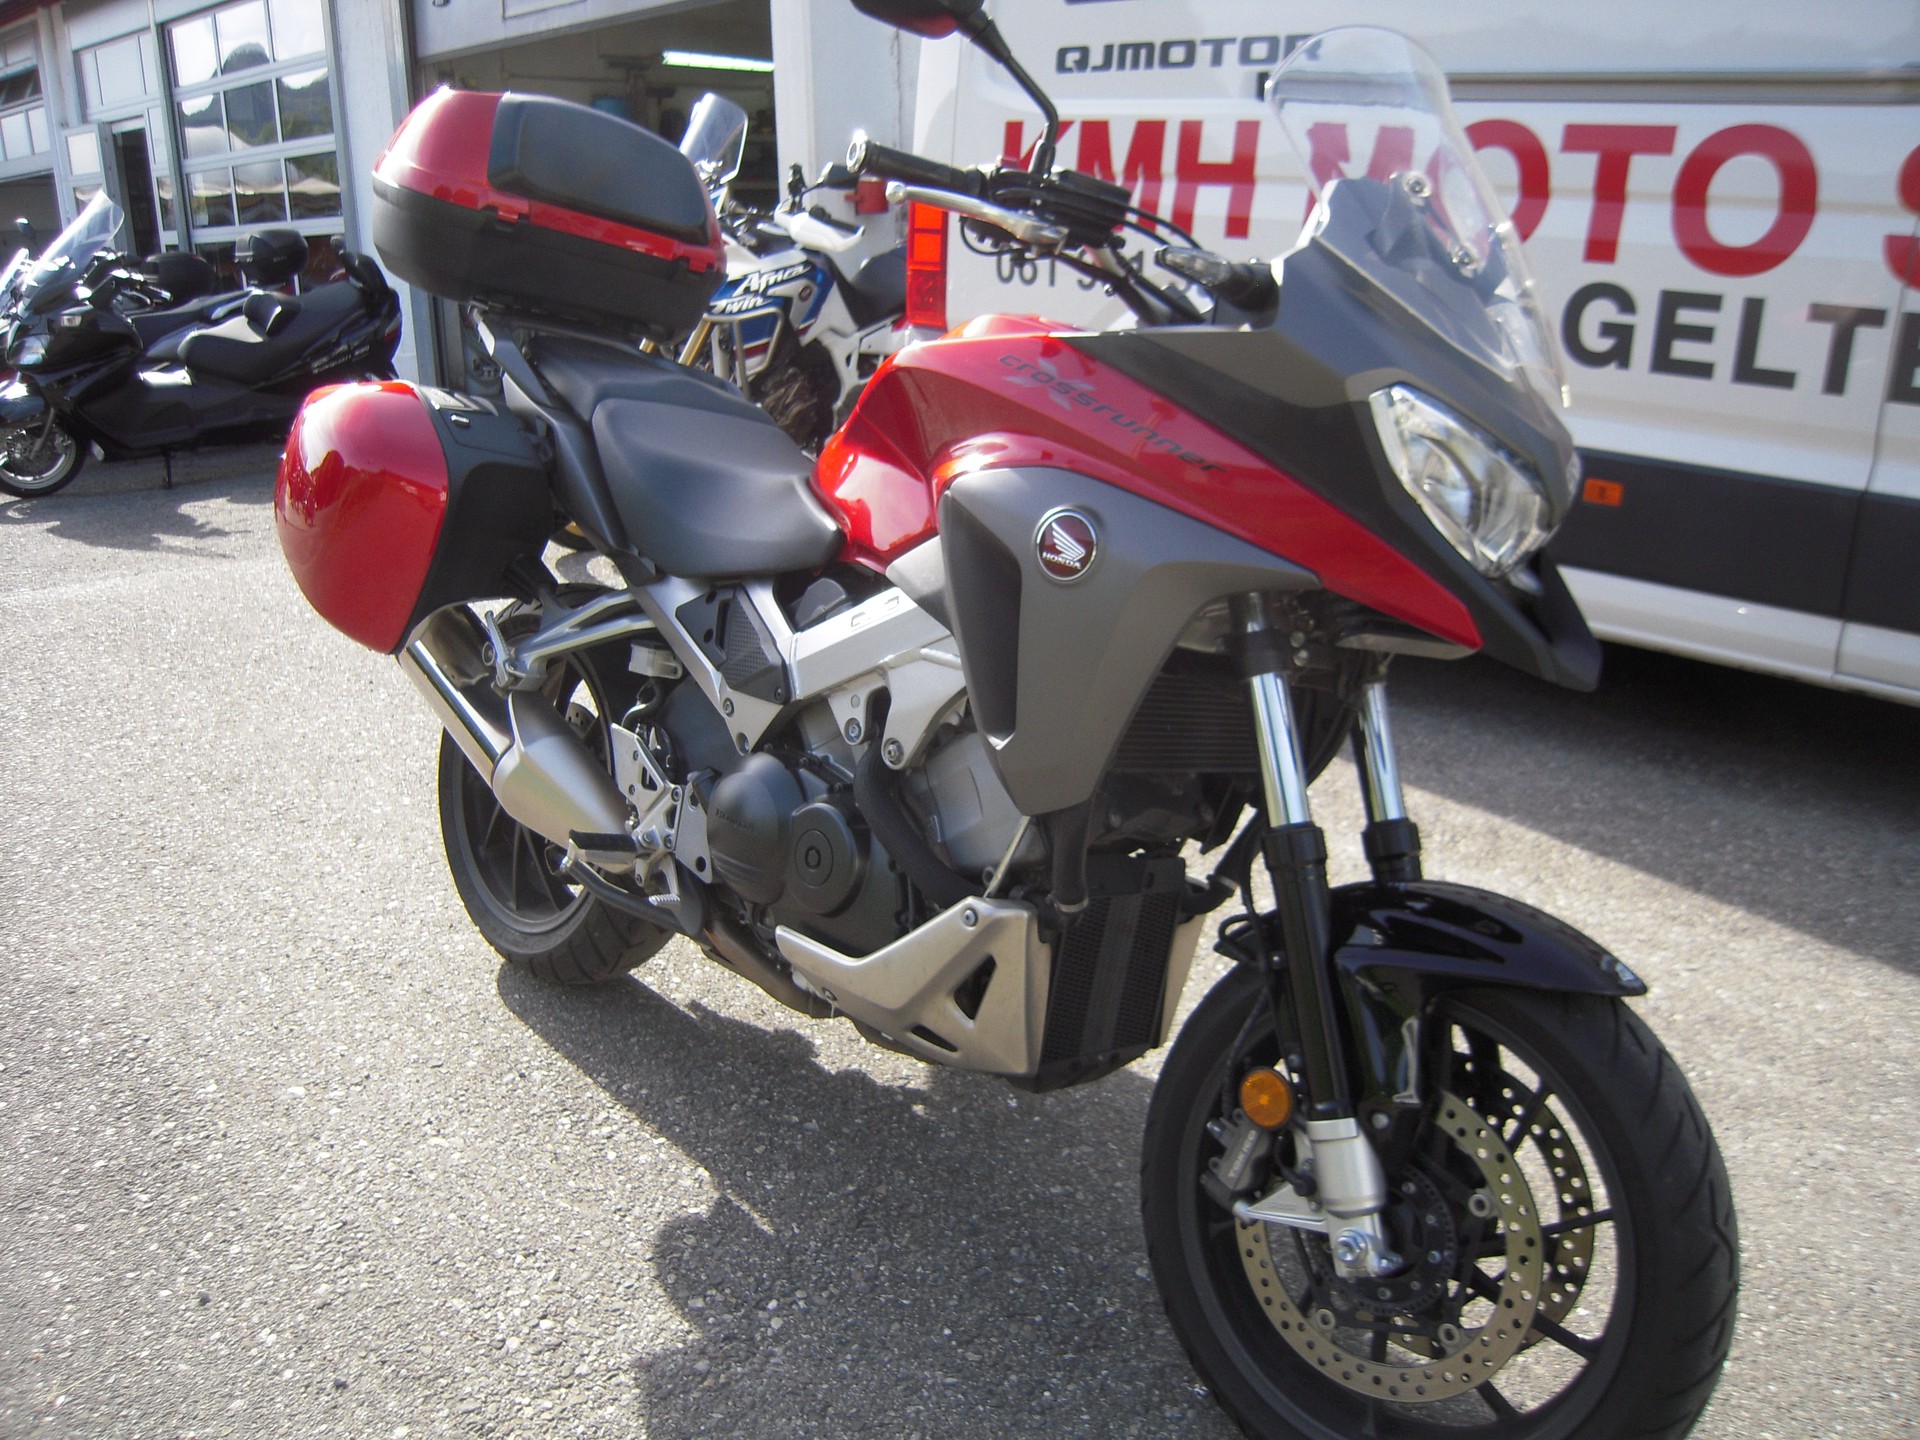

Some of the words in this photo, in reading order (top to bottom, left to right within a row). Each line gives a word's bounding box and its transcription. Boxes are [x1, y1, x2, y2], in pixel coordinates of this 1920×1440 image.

[1055, 34, 1322, 75] QJMOTOR
[1003, 119, 1261, 239] KMH
[1302, 119, 1818, 277] MOTO
[731, 264, 811, 298] Africa
[709, 294, 773, 314] Twin
[998, 354, 1228, 473] crossrunner
[1041, 551, 1082, 570] HONDA
